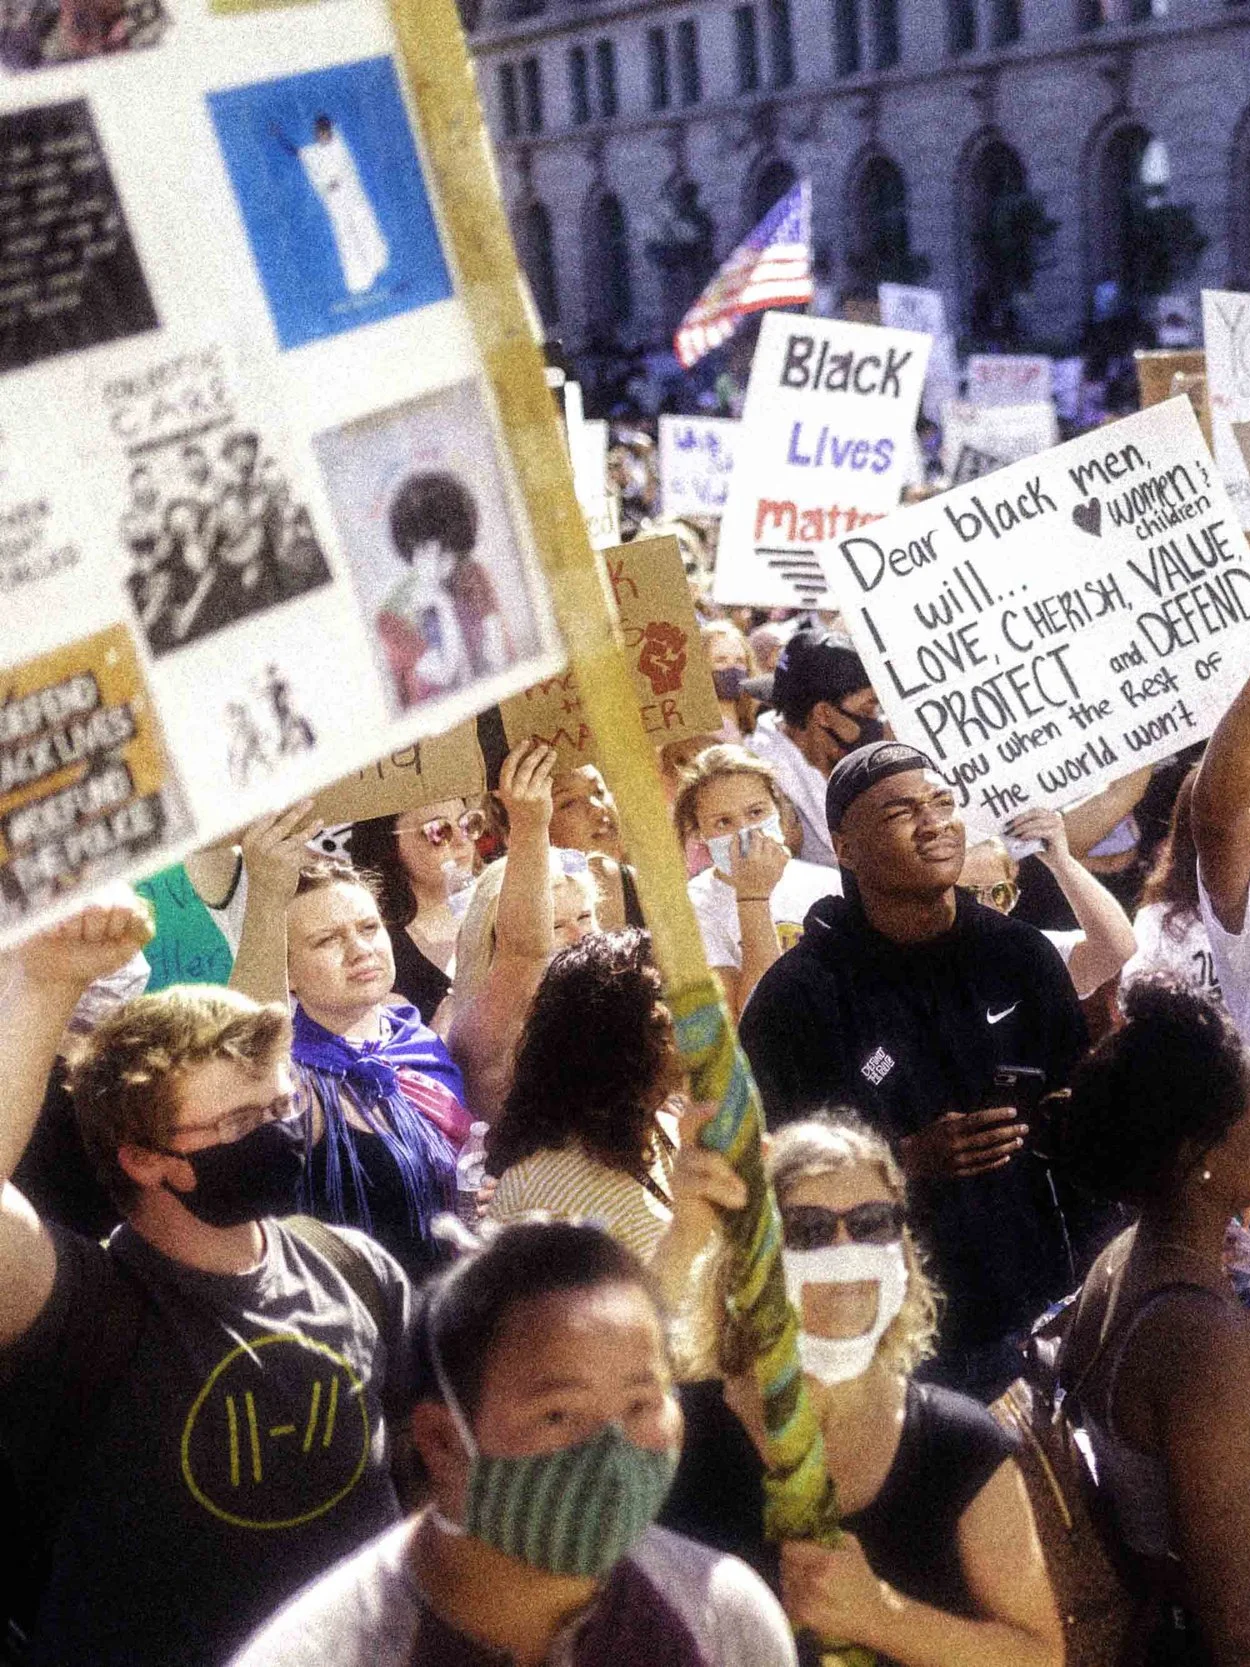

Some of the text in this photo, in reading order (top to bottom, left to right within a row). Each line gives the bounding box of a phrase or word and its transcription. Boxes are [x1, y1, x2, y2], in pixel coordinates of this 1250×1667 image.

[780, 334, 913, 398] Black
[838, 443, 1153, 594] Dear black men,
[1107, 466, 1195, 529] women
[1134, 495, 1212, 542] children
[861, 560, 1029, 654] I will...
[885, 620, 1001, 699] LOVE,
[1000, 572, 1134, 654] CHERISH,
[914, 643, 1082, 761] PROTECT
[1108, 635, 1149, 675] and
[941, 755, 992, 809] you
[995, 718, 1062, 766] when
[1067, 695, 1113, 733] the
[979, 781, 1031, 819] the
[1037, 735, 1119, 796] world
